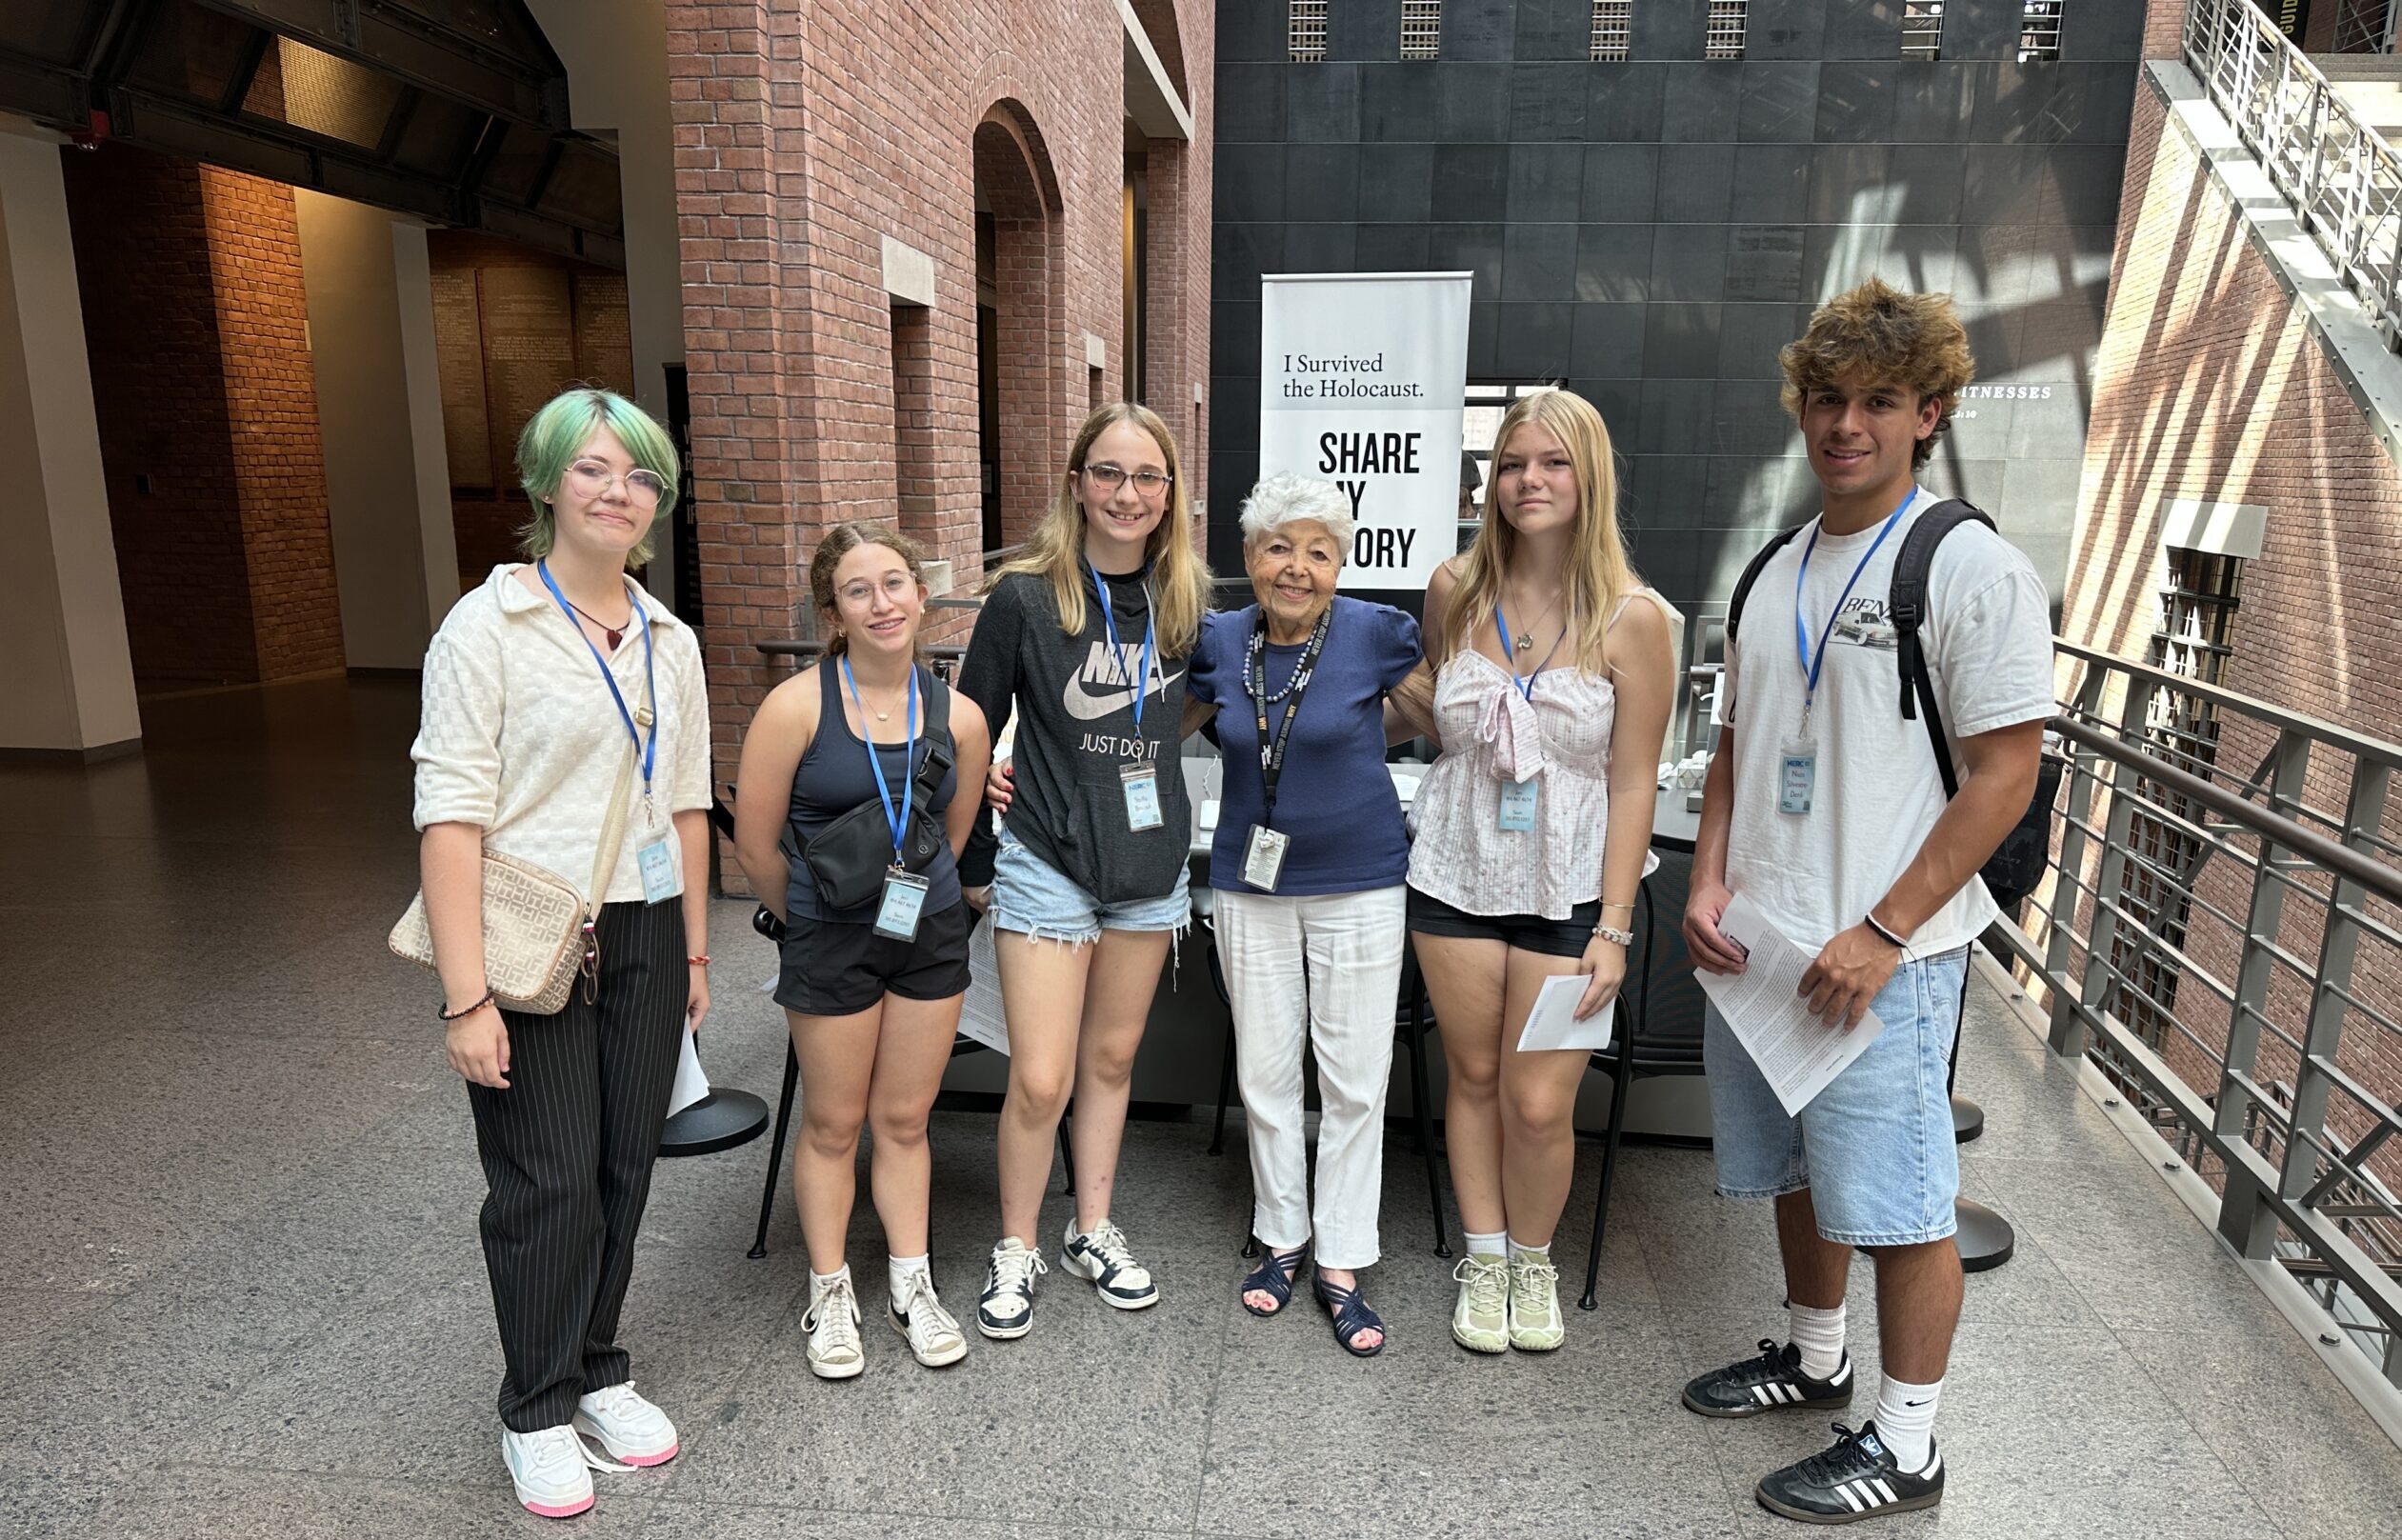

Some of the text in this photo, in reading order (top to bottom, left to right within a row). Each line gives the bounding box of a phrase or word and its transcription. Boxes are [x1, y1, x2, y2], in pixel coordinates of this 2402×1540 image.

[1284, 352, 1383, 372] I Survived
[1283, 378, 1424, 397] the Holocaust.
[1953, 386, 2052, 399] ITNESSES
[1318, 431, 1421, 474] SHARE
[1336, 480, 1367, 521] Y
[1342, 527, 1416, 569] ORY
[1078, 732, 1161, 759] JUST DO IT
